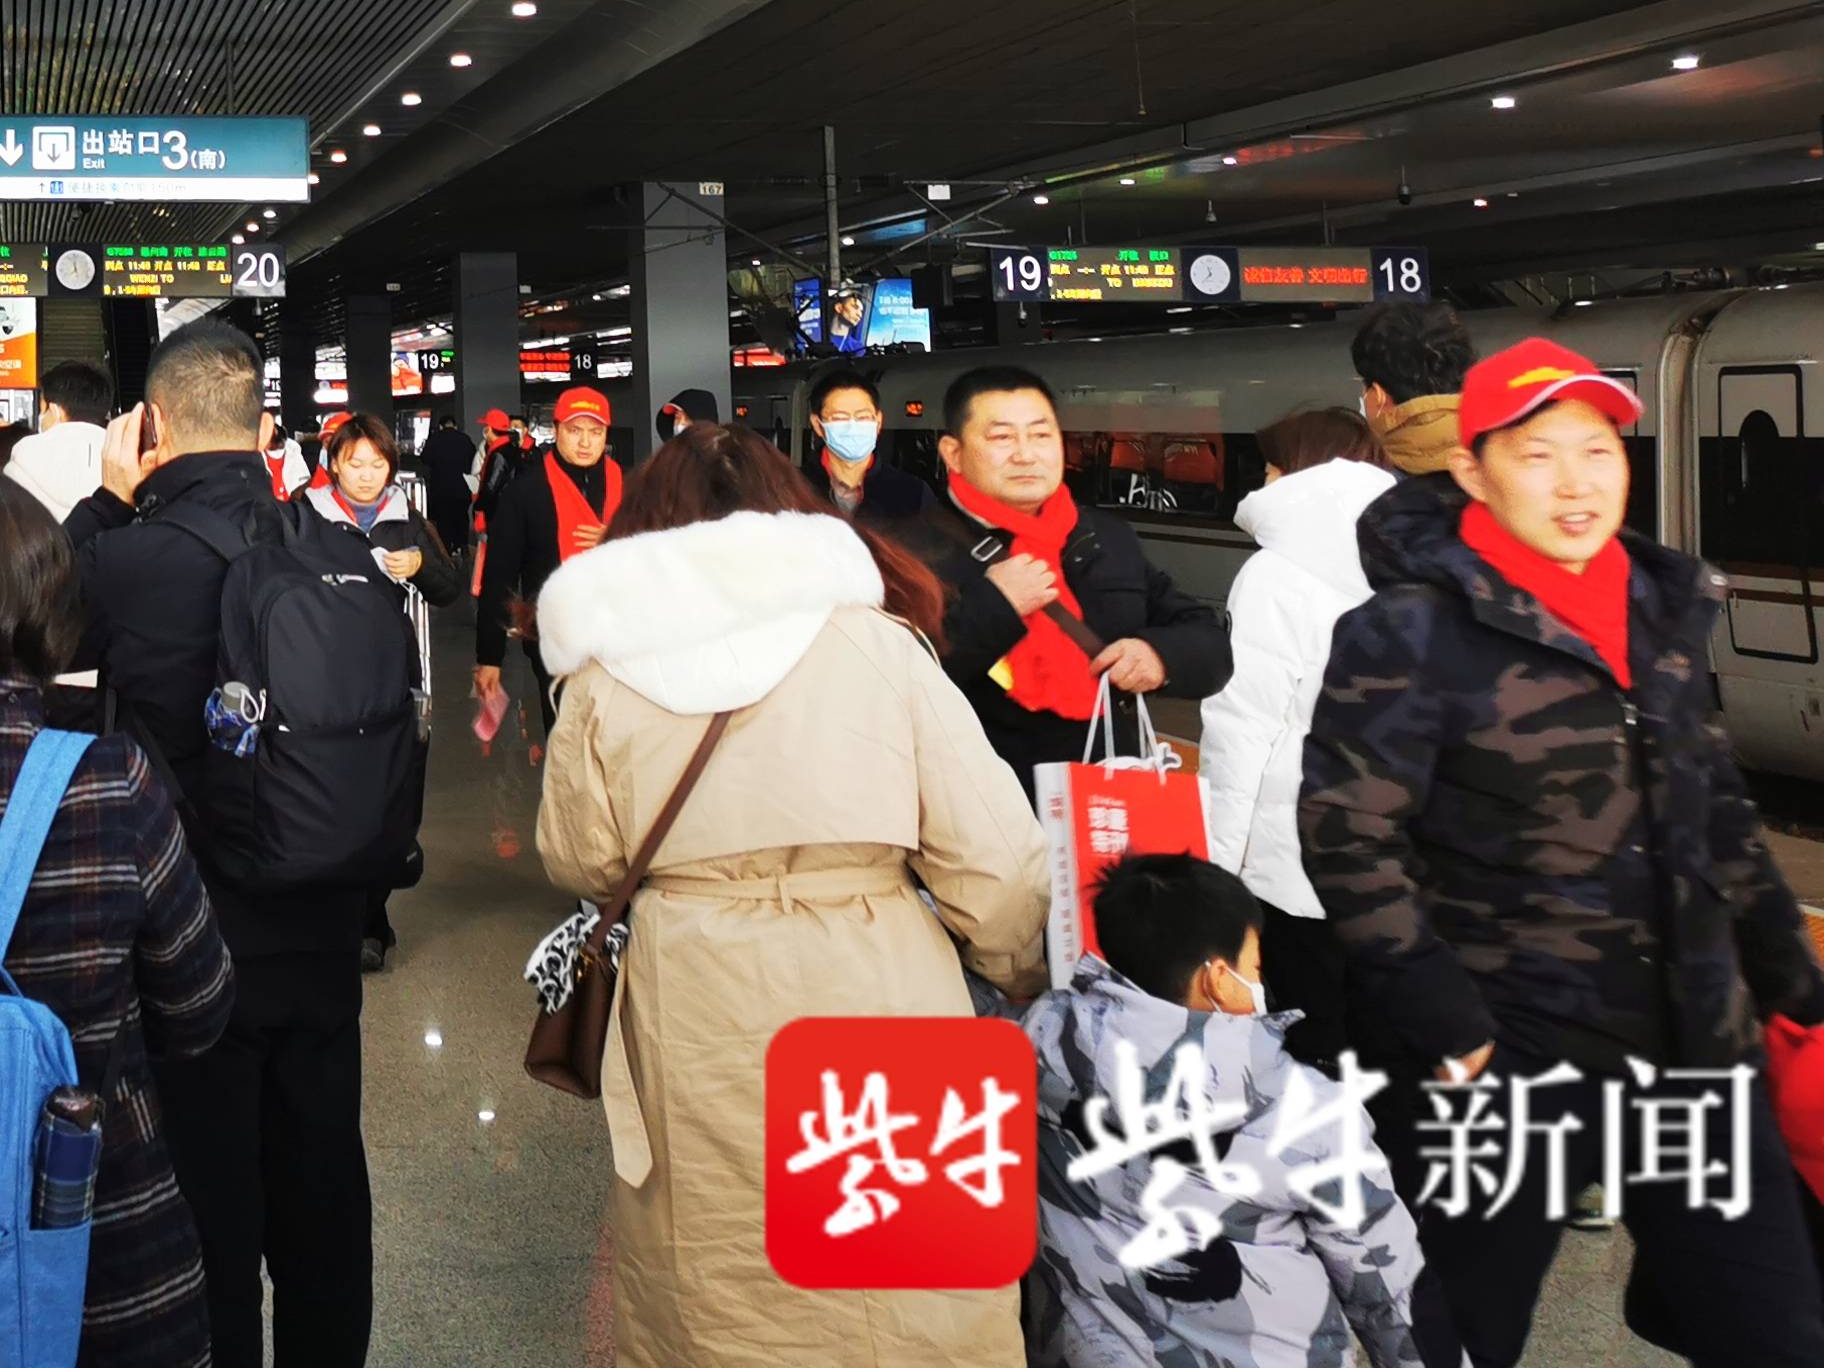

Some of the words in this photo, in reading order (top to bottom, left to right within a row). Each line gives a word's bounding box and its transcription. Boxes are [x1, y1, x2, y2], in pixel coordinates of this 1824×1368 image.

[83, 158, 106, 170] Exit
[237, 252, 280, 289] 20
[999, 256, 1042, 292] 19
[1379, 257, 1423, 293] 18
[160, 274, 174, 284] TO
[421, 354, 439, 370] 19
[575, 354, 592, 370] 18
